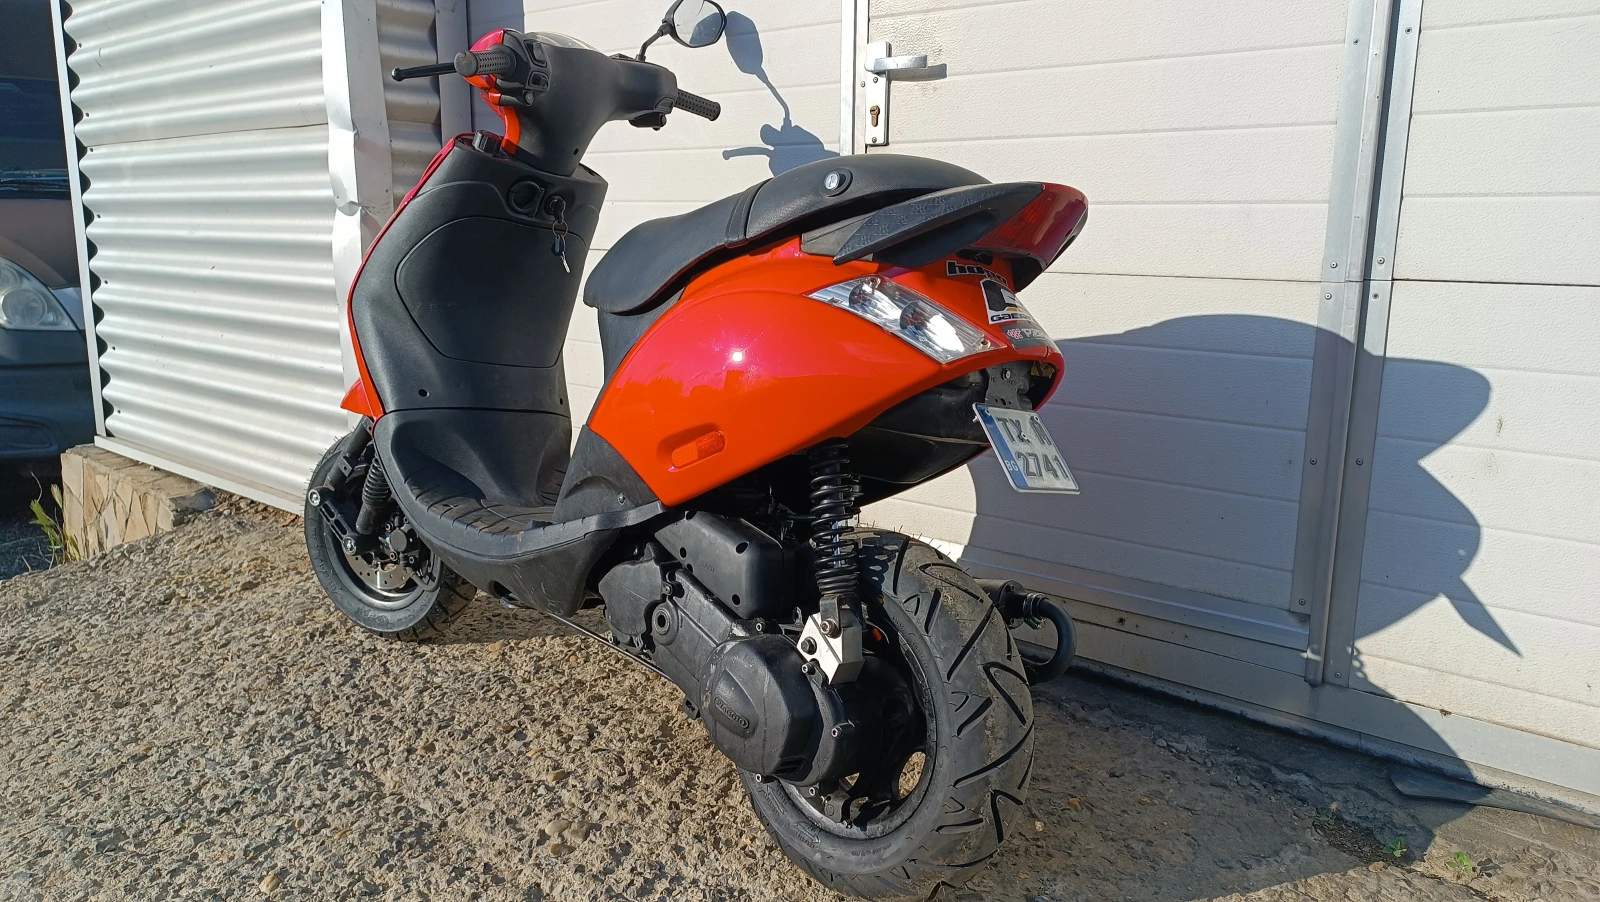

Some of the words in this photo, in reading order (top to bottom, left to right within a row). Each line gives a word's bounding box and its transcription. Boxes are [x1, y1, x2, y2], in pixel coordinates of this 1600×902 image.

[996, 418, 1032, 444] TX
[1004, 460, 1019, 472] BG
[1015, 451, 1070, 480] 2741
